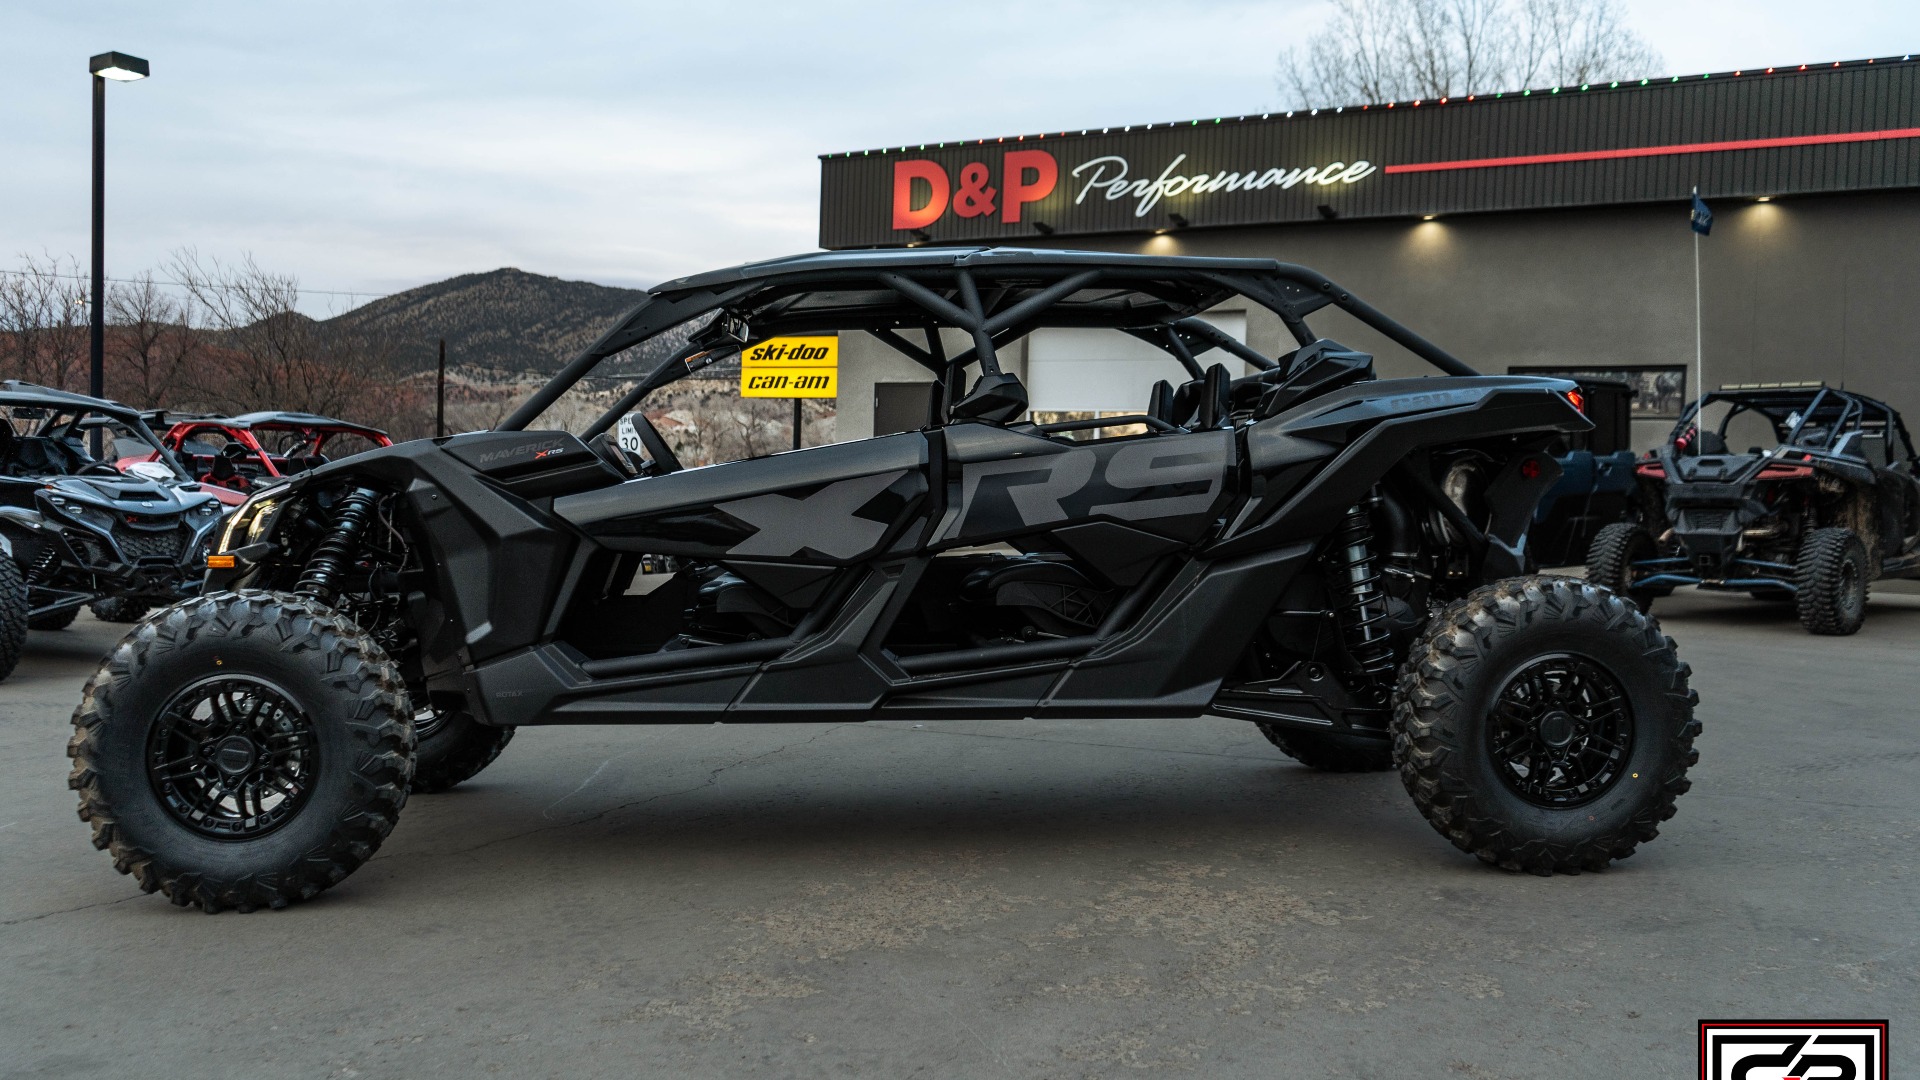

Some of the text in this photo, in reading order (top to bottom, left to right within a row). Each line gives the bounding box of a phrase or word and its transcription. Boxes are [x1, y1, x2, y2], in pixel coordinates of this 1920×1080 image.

[892, 149, 1377, 230] D&P Performance
[750, 344, 829, 360] ski-doo
[748, 376, 830, 389] can-am
[479, 437, 565, 463] MAVERICK
[622, 437, 638, 451] 30
